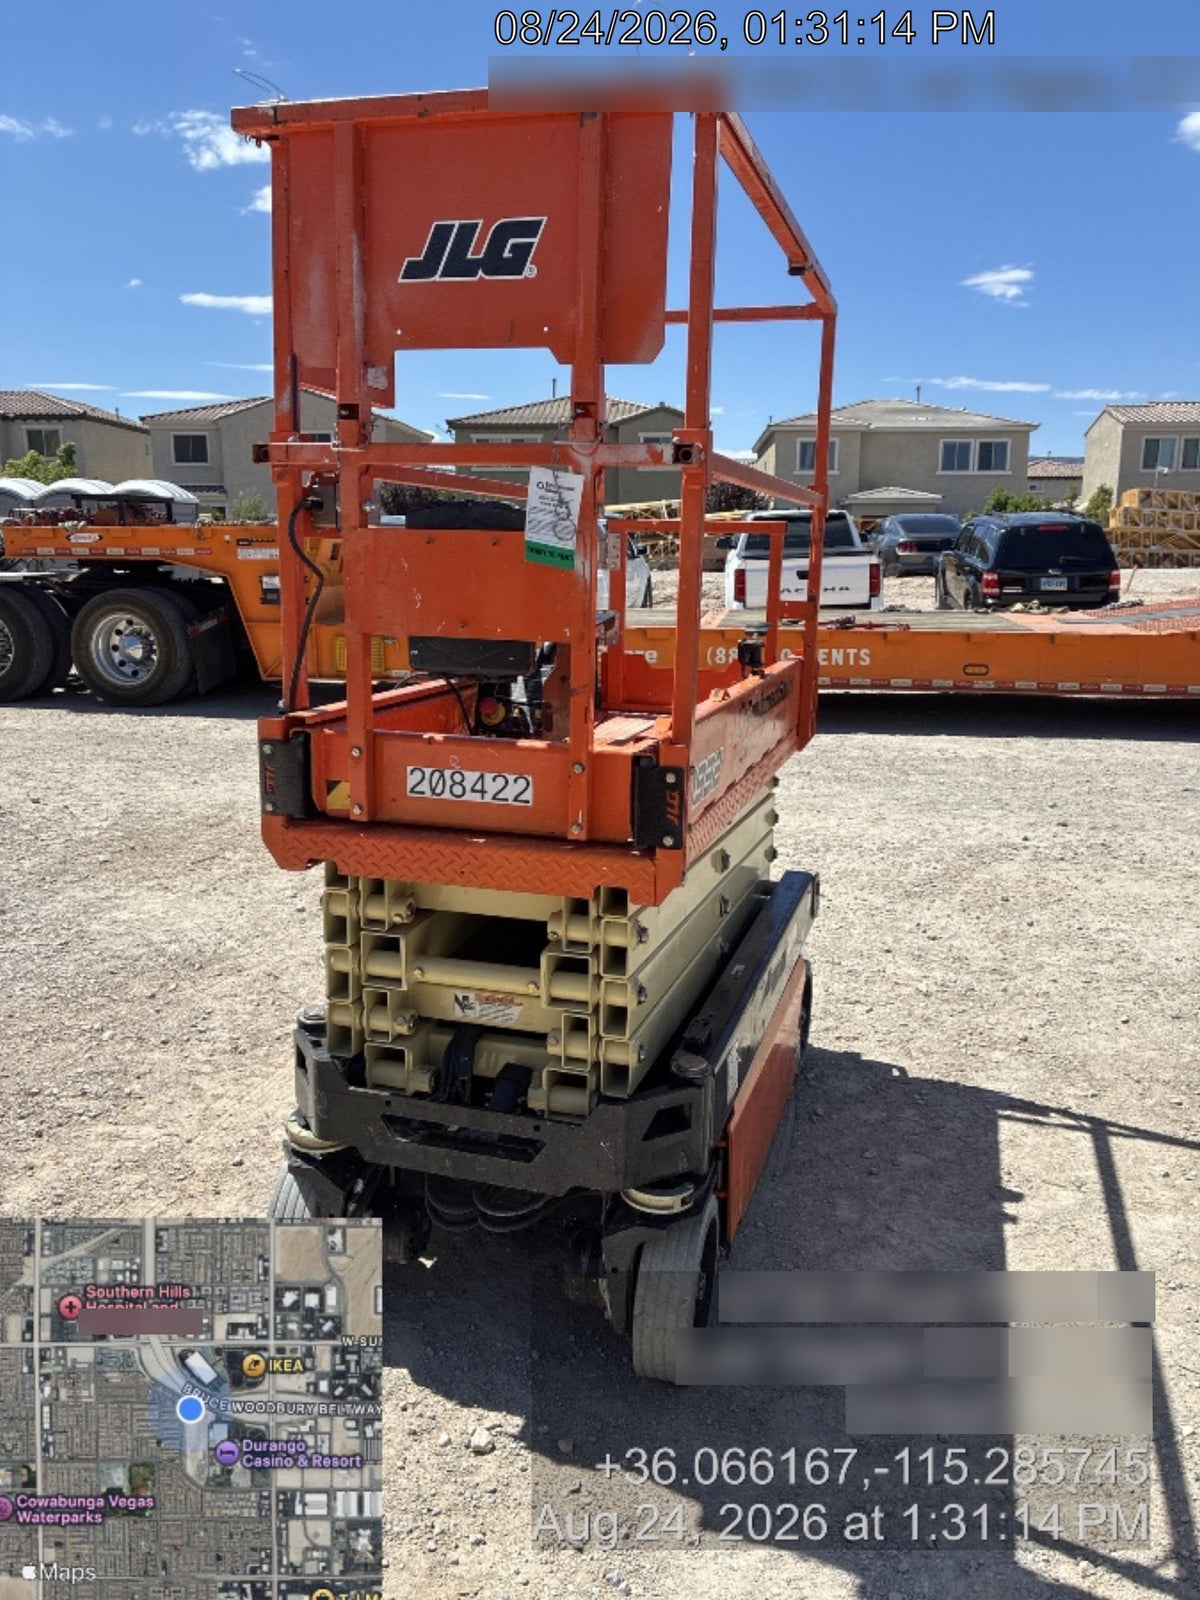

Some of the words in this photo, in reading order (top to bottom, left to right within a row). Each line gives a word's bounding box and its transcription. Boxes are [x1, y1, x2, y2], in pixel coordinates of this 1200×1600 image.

[398, 216, 548, 283] JLG
[408, 767, 531, 804] 208422
[666, 790, 680, 826] JLG
